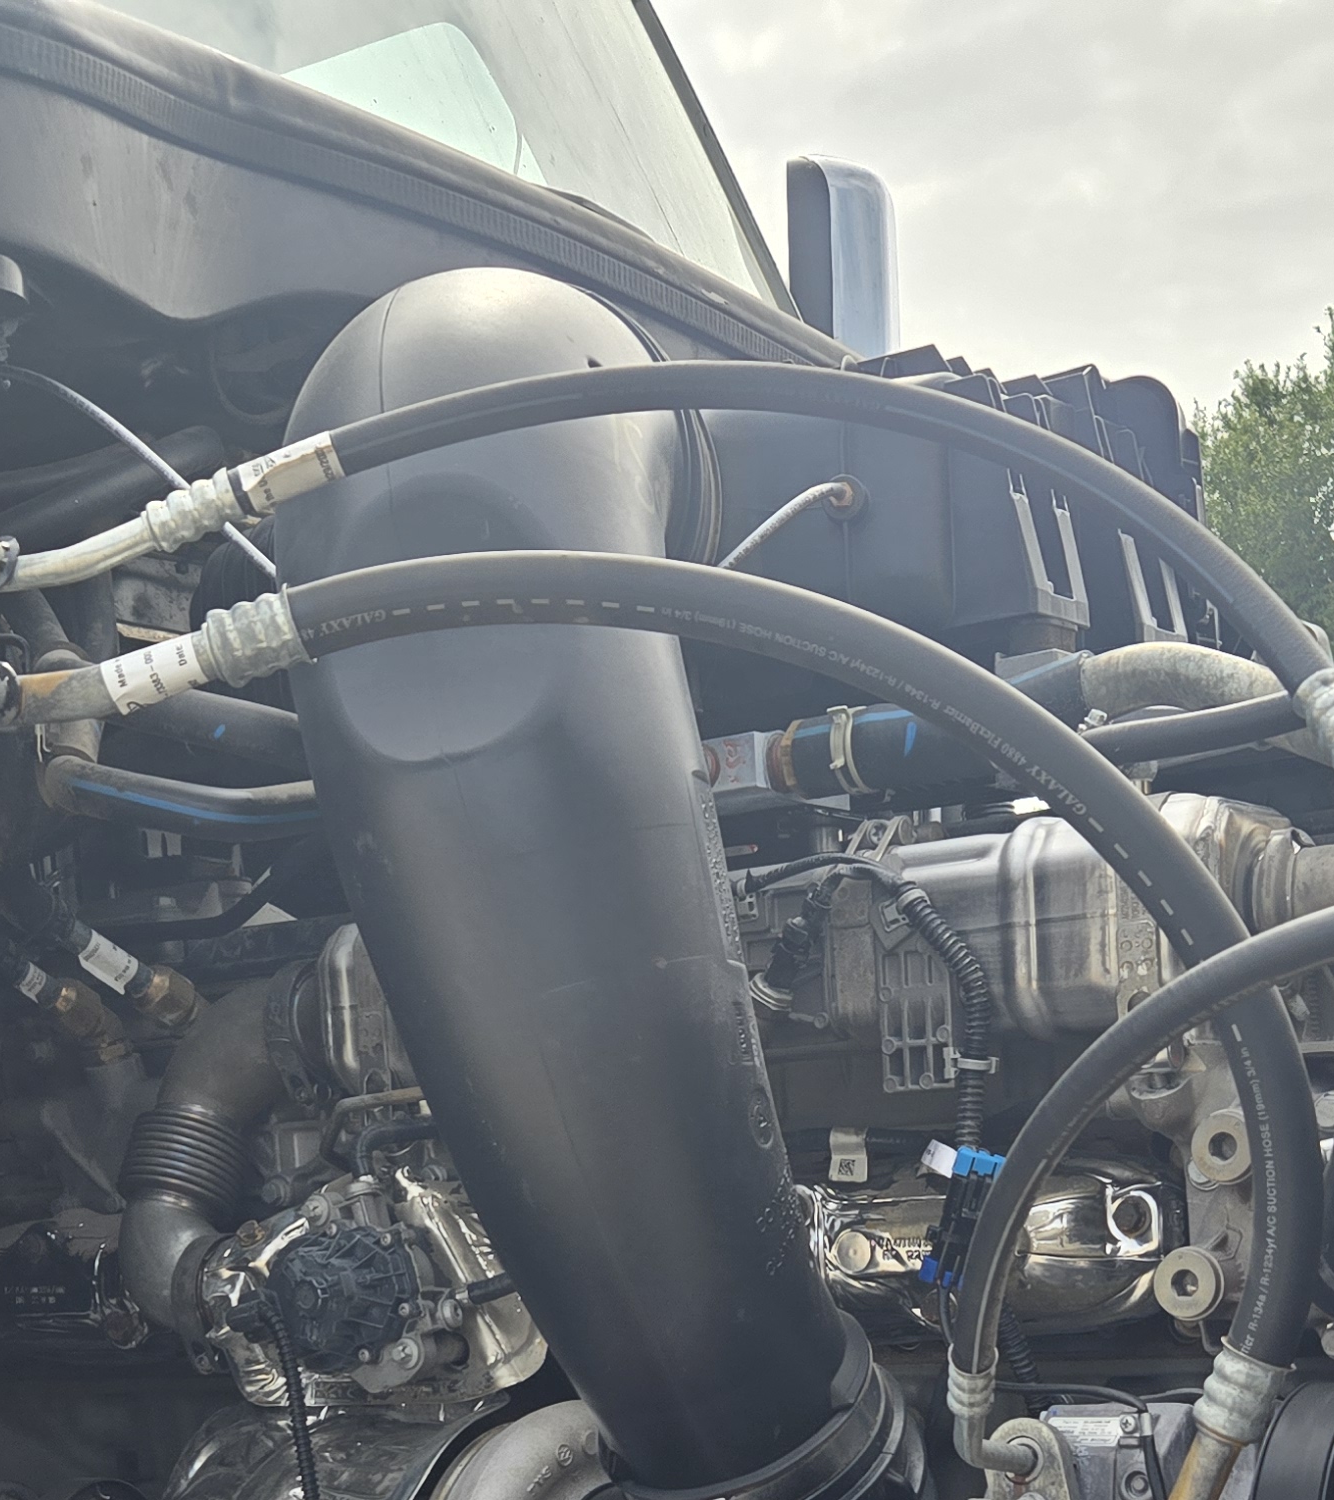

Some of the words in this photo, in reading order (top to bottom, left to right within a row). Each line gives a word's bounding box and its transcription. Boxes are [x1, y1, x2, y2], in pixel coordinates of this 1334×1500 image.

[320, 608, 386, 638] GALAXY
[674, 608, 692, 622] 3/4
[694, 609, 736, 631] (19mm)
[738, 621, 772, 639] HOSE
[774, 631, 828, 659] SUCTION
[828, 649, 850, 666] A/C
[114, 664, 128, 688] Made
[849, 655, 897, 687] R-1234yf
[903, 684, 941, 711] R-134a
[942, 704, 1002, 750] FlexBarrier
[999, 742, 1027, 768] 4880
[1025, 763, 1088, 817] GALAXY
[1244, 1060, 1258, 1078] 3/4
[1250, 1079, 1270, 1122] (19mm)
[1259, 1123, 1273, 1158] HOSE
[1264, 1160, 1278, 1214] SUCTION
[1266, 1215, 1278, 1237] A/C
[1259, 1237, 1278, 1286] R-1234yf
[1246, 1295, 1266, 1332] R-134a
